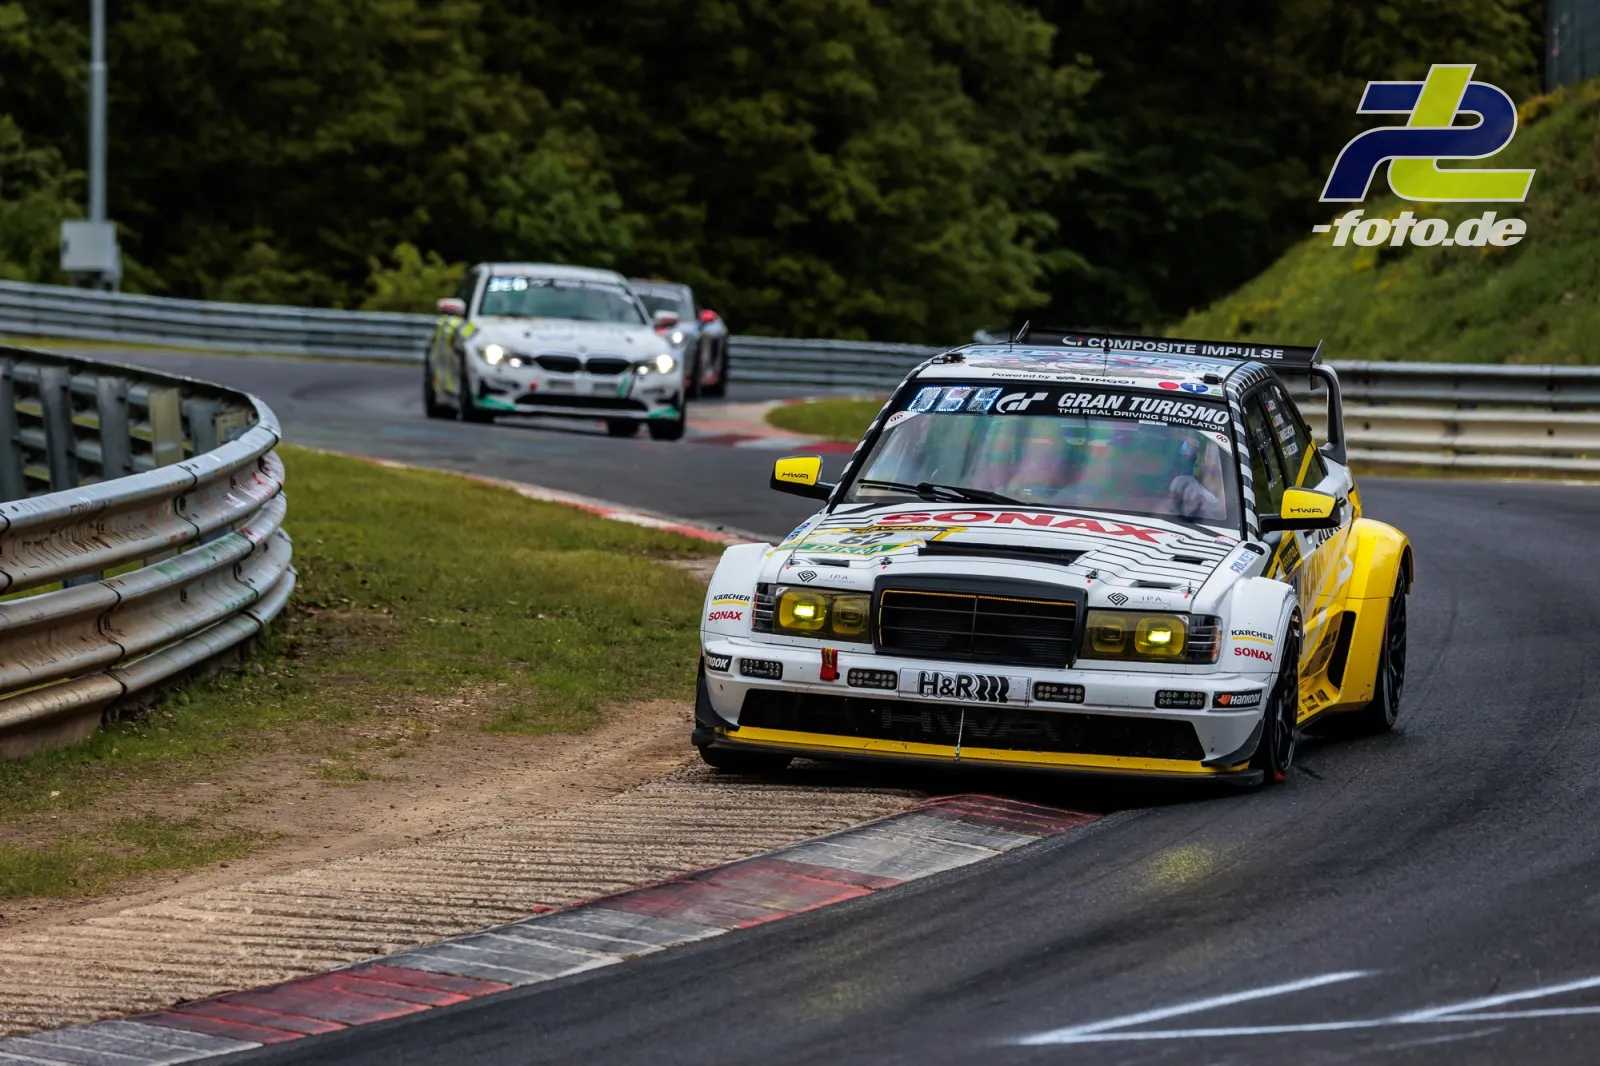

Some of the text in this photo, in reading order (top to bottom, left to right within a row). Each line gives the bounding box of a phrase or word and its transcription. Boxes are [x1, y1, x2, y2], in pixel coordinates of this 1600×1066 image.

[1087, 337, 1197, 355] COMPOSITE
[1202, 344, 1284, 360] IMPULSE
[991, 371, 1036, 379] Powered
[1058, 392, 1230, 425] GRAN TURISMO
[1058, 407, 1226, 432] THE REAL DRIVING SIMULATOR
[781, 472, 809, 480] HWA
[876, 511, 1166, 544] SONAX
[838, 532, 895, 546] 62
[813, 544, 883, 556] DEKRA
[708, 611, 743, 621] SONAX
[1234, 647, 1273, 662] SONAX
[918, 671, 979, 700] H&R
